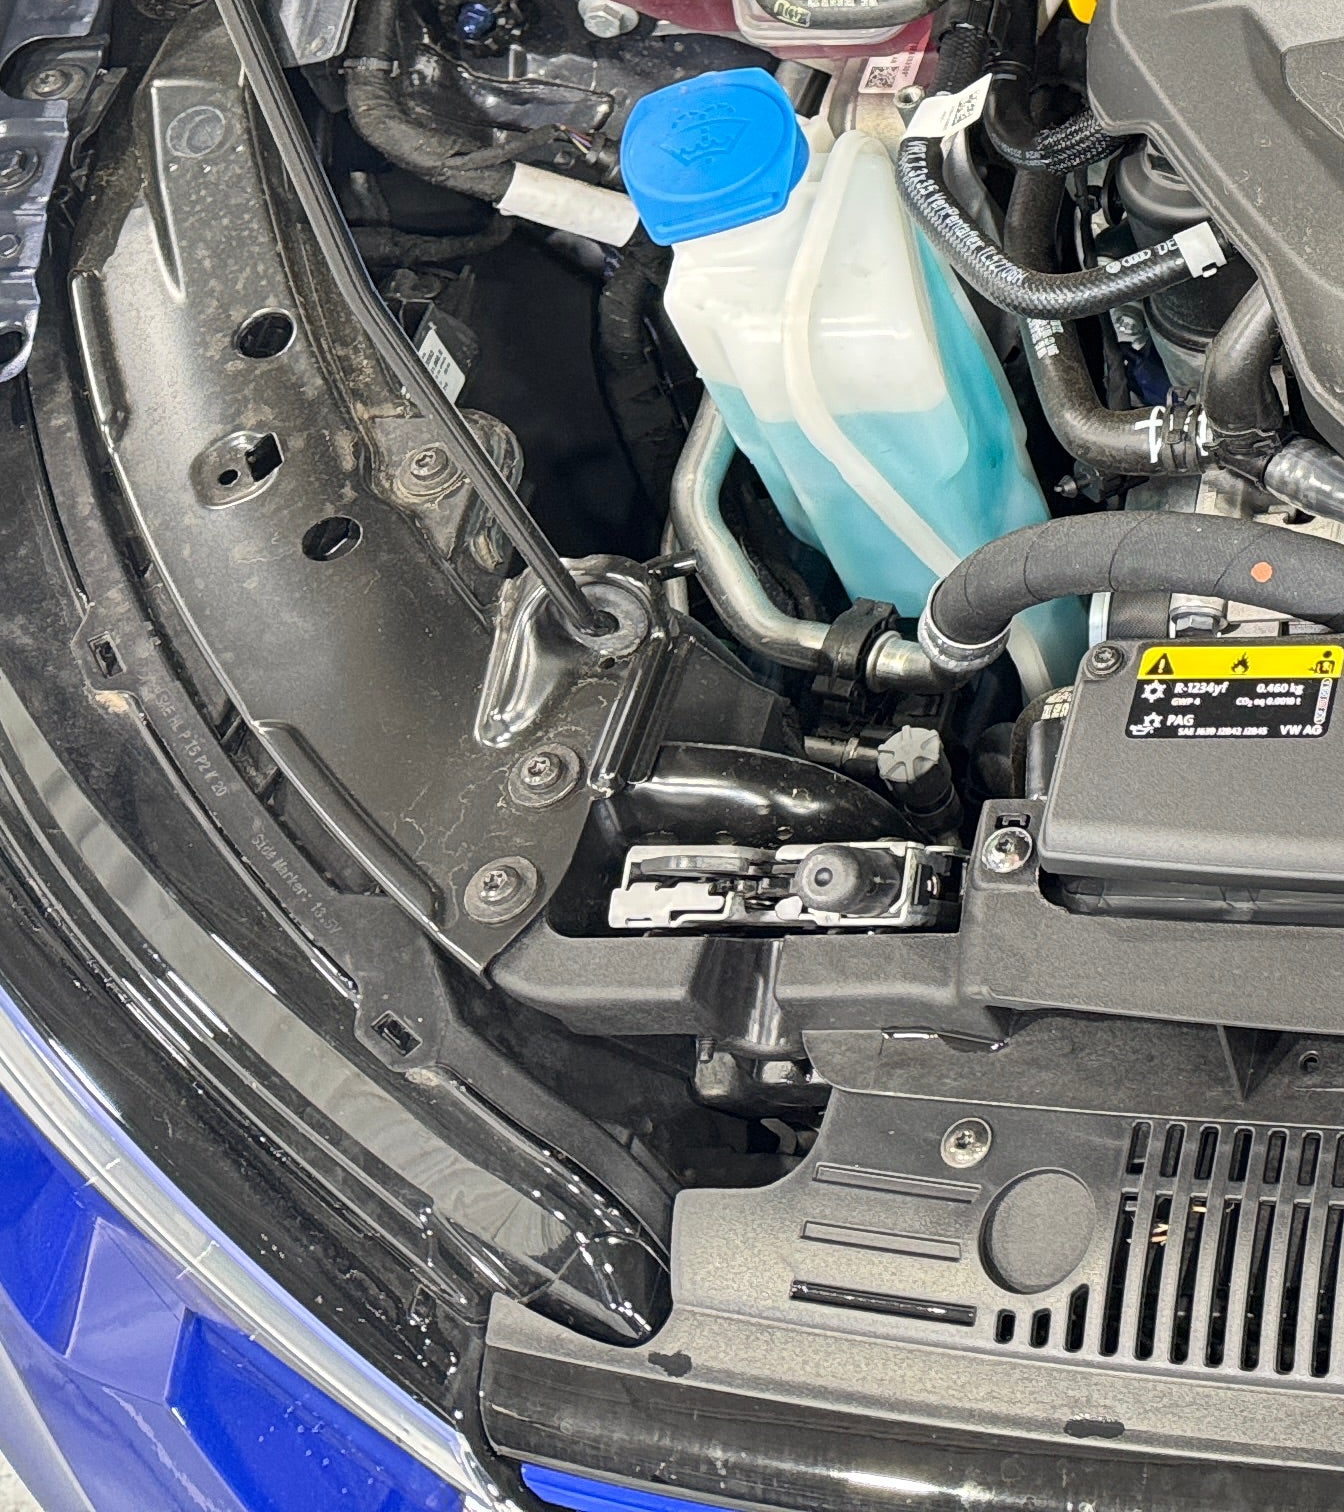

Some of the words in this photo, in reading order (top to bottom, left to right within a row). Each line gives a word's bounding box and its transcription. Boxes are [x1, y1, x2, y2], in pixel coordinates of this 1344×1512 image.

[1172, 681, 1229, 695] R-1234yf
[1255, 682, 1290, 693] 0.460
[1287, 682, 1305, 695] kg
[1165, 714, 1195, 726] PAG
[1278, 724, 1302, 735] VW
[1301, 724, 1323, 735] AG
